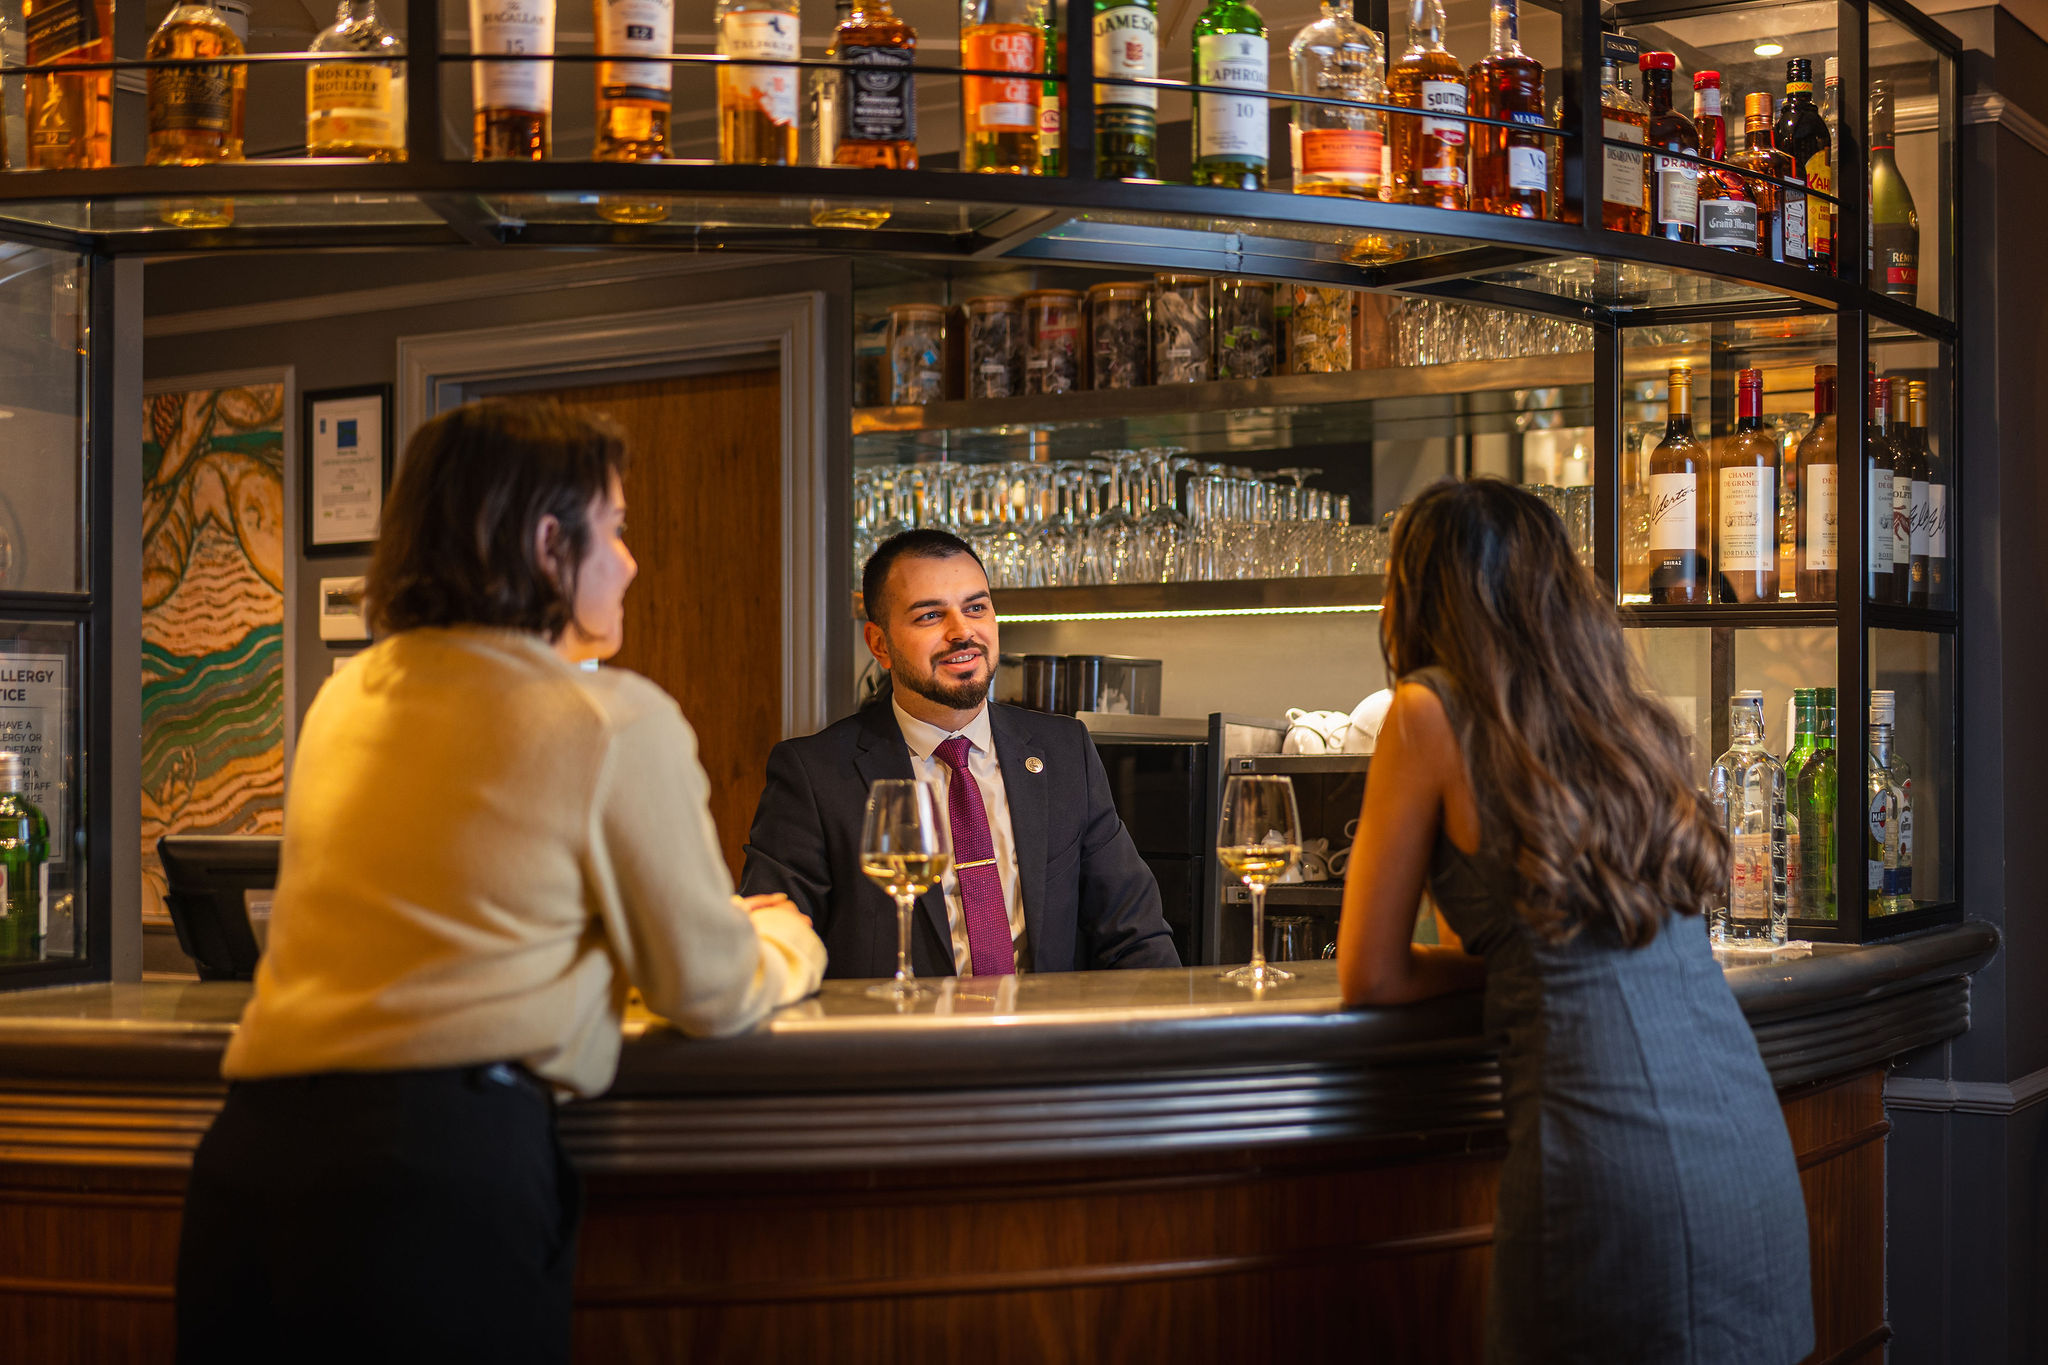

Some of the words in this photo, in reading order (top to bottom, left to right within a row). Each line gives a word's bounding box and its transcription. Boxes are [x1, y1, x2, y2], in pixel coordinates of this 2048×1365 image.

[991, 35, 1033, 53] GLEN
[315, 69, 373, 79] MONKEY
[313, 81, 379, 92] SHOULDER
[1236, 104, 1255, 117] 10
[1709, 217, 1733, 229] Grand
[26, 721, 33, 729] A
[29, 733, 42, 742] OR
[24, 782, 51, 791] STAFF
